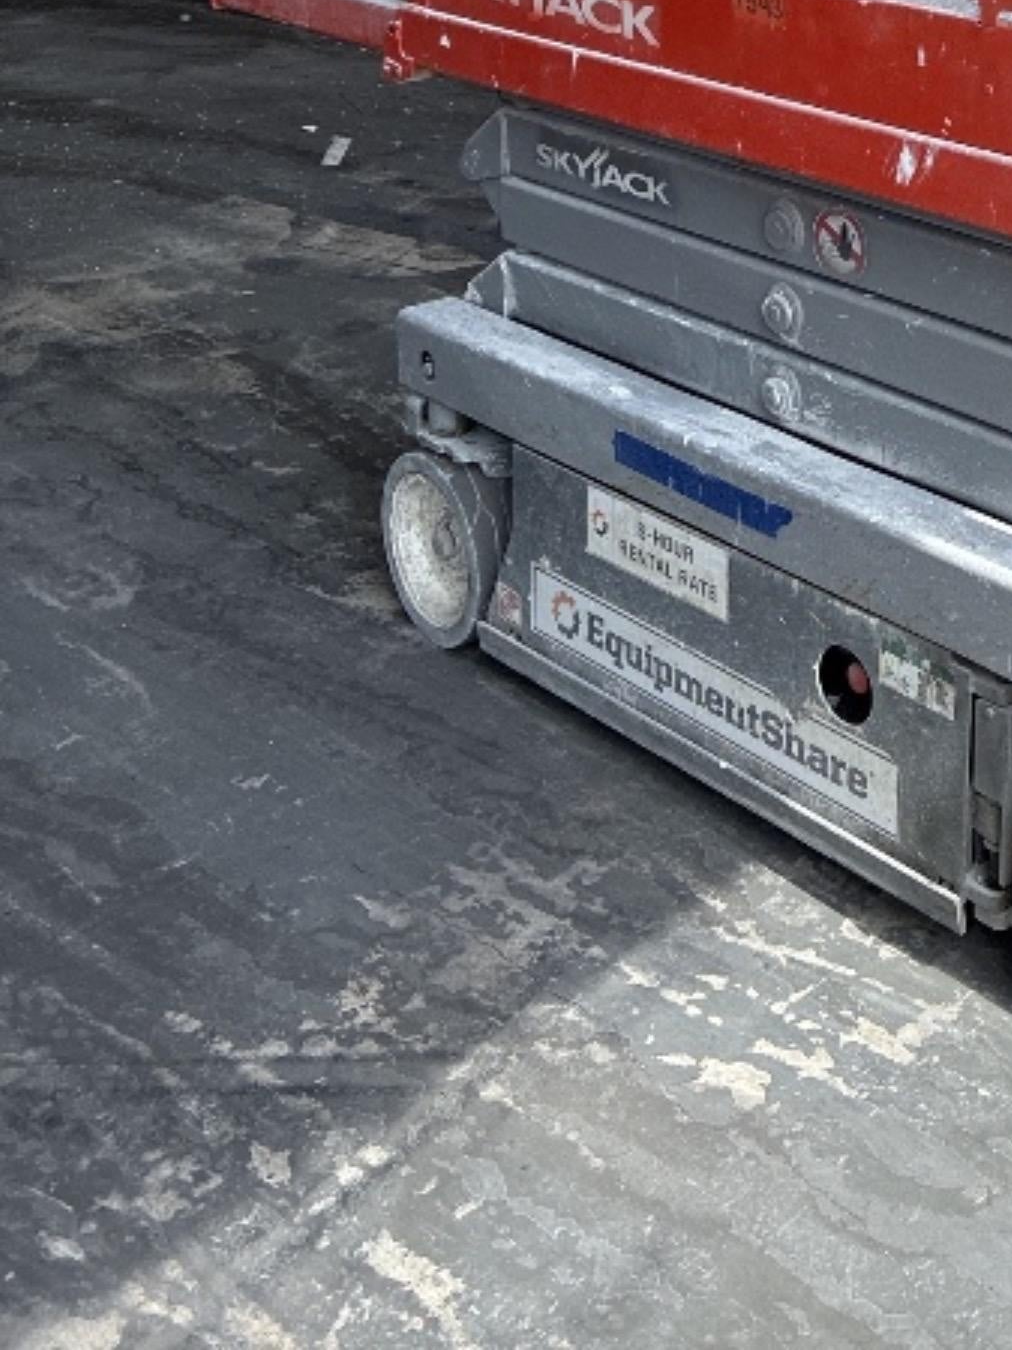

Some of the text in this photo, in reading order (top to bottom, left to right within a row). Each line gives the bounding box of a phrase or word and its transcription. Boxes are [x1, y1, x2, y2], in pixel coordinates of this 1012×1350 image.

[535, 143, 672, 207] SKYJACK
[618, 538, 673, 580] RENTAL
[677, 568, 719, 604] RATE
[586, 611, 869, 799] EquipmentShare
